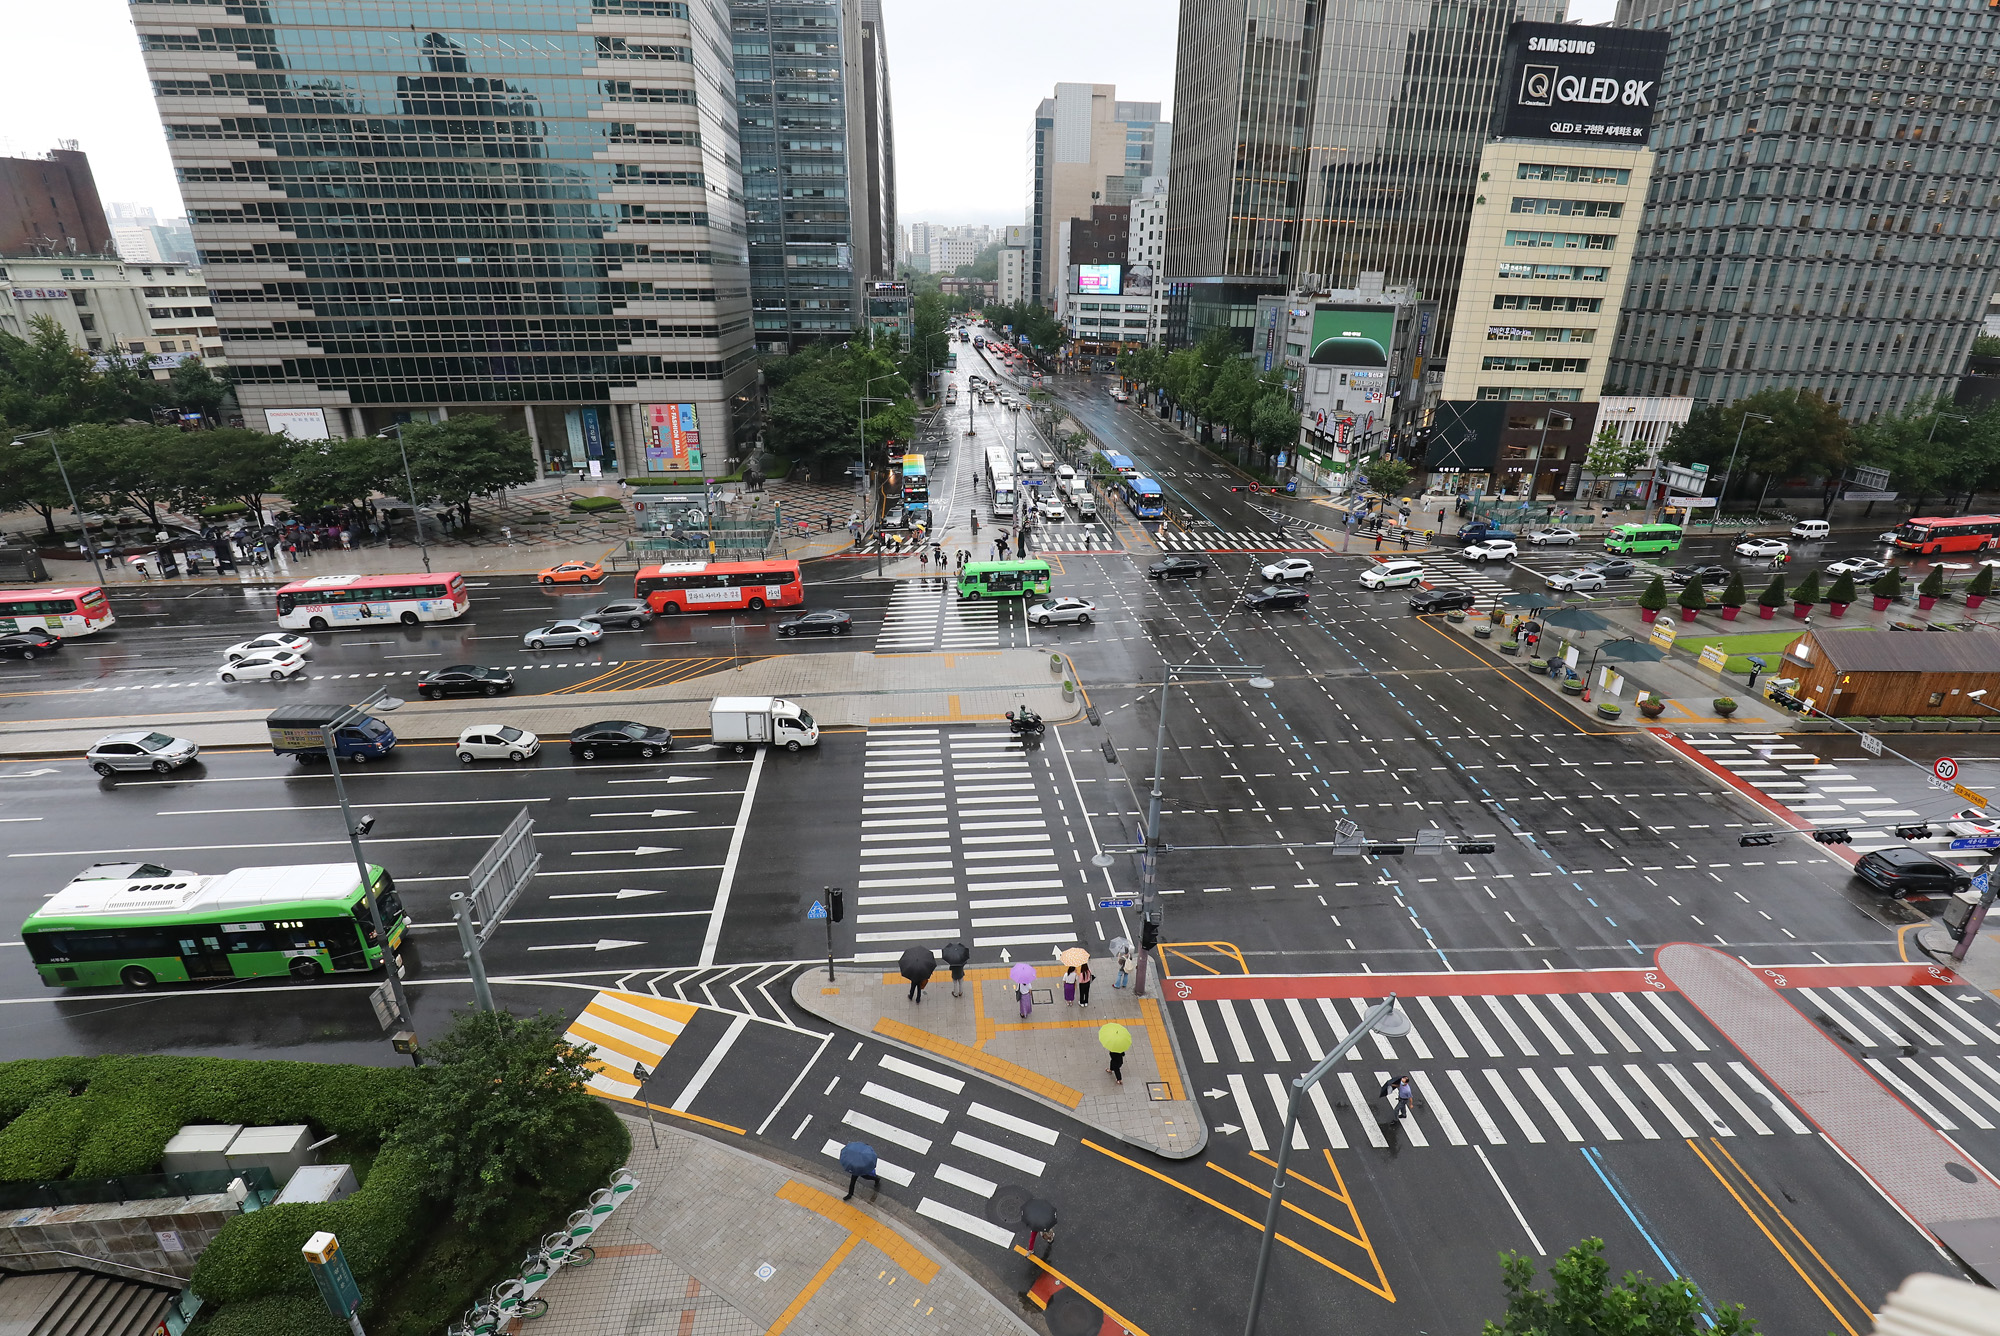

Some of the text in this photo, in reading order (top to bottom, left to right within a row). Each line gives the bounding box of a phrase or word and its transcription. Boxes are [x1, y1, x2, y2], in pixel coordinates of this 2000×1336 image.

[1528, 36, 1596, 55] SAMSUNG
[1556, 75, 1654, 107] QLED 8K
[1550, 122, 1643, 137] QLED 로 구현한 세계최초 8K
[670, 405, 680, 439] K-FASHION
[1183, 471, 1203, 479] 50
[305, 605, 323, 613] 5000
[1937, 761, 1955, 778] 50
